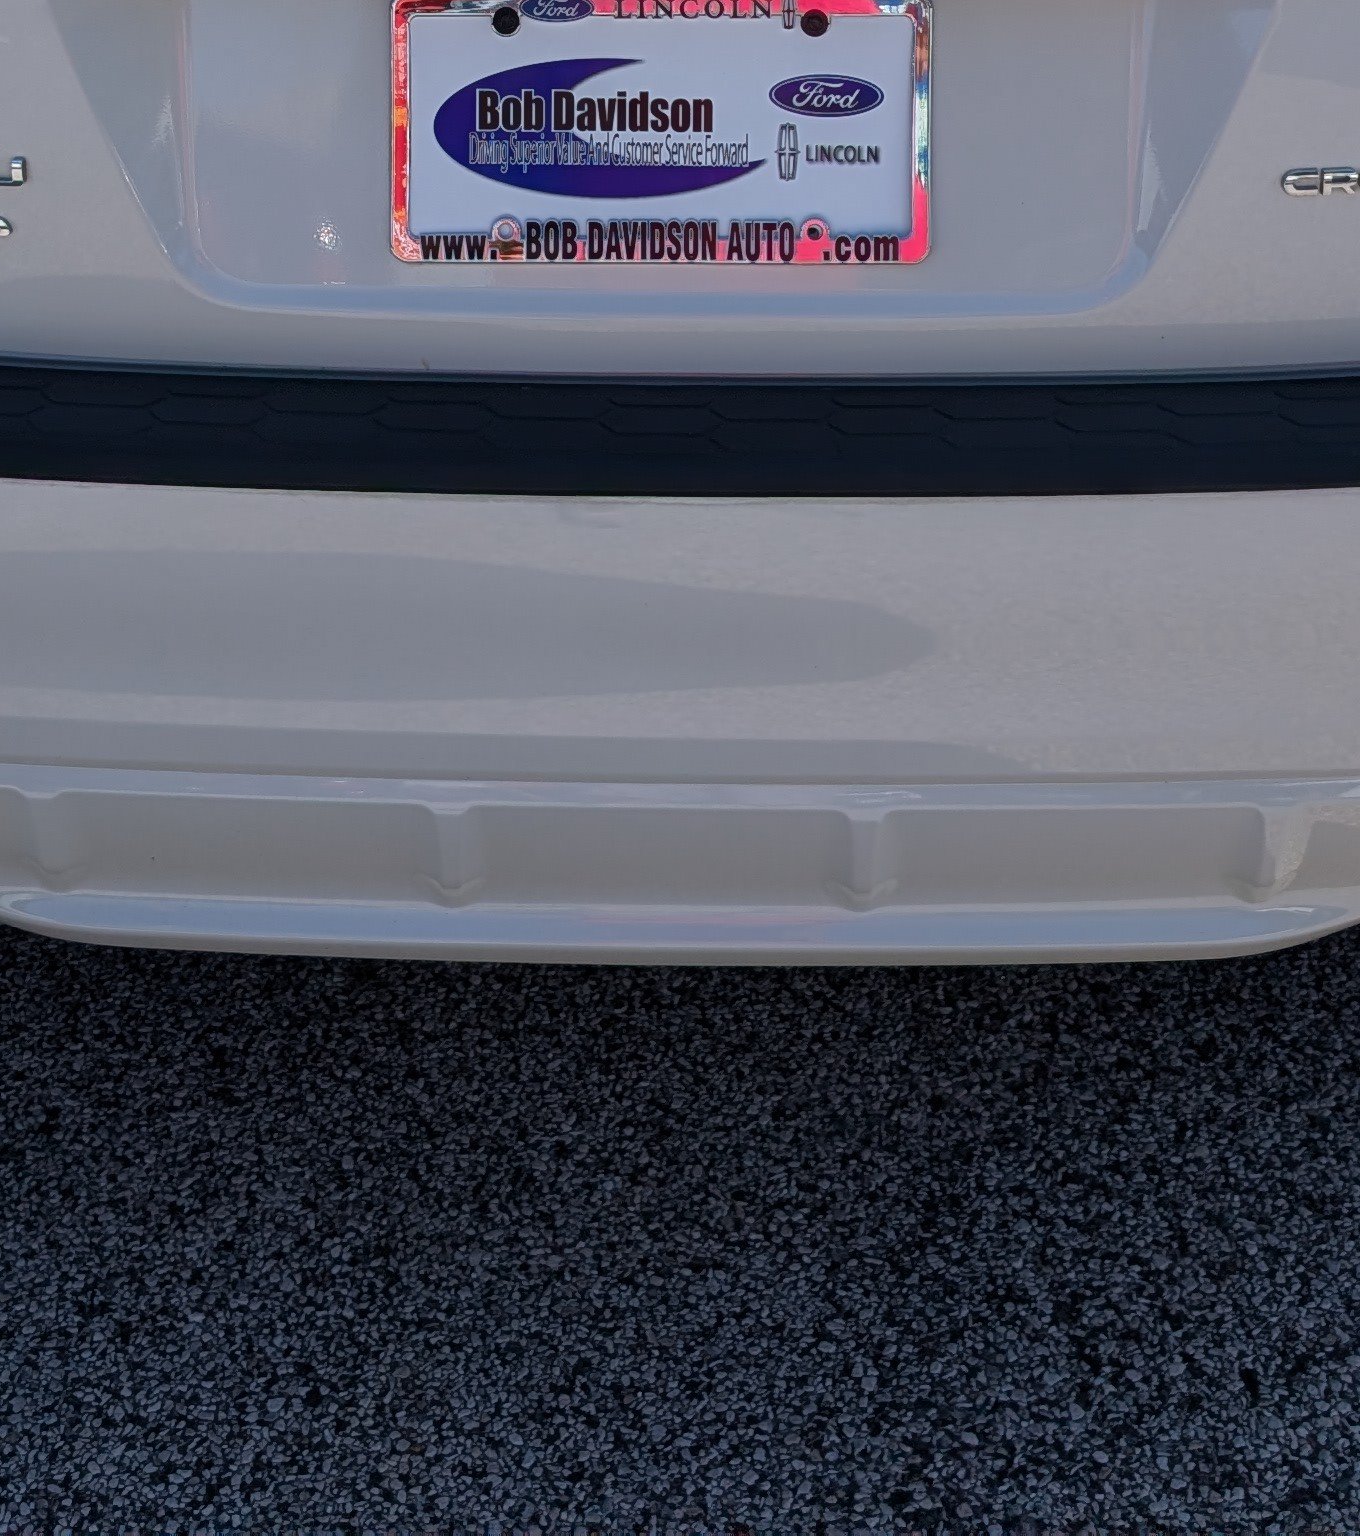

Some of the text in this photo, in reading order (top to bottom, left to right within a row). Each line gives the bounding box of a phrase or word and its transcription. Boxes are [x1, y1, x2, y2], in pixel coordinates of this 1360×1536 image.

[477, 89, 713, 133] Bob Davidson
[792, 80, 860, 109] Ford
[469, 133, 749, 173] Driving Superior Value And Customer Service Forward
[805, 145, 880, 163] LINCOLN
[526, 221, 577, 260] BOB
[587, 221, 717, 261] DAVIDSON
[727, 221, 794, 261] AUTO
